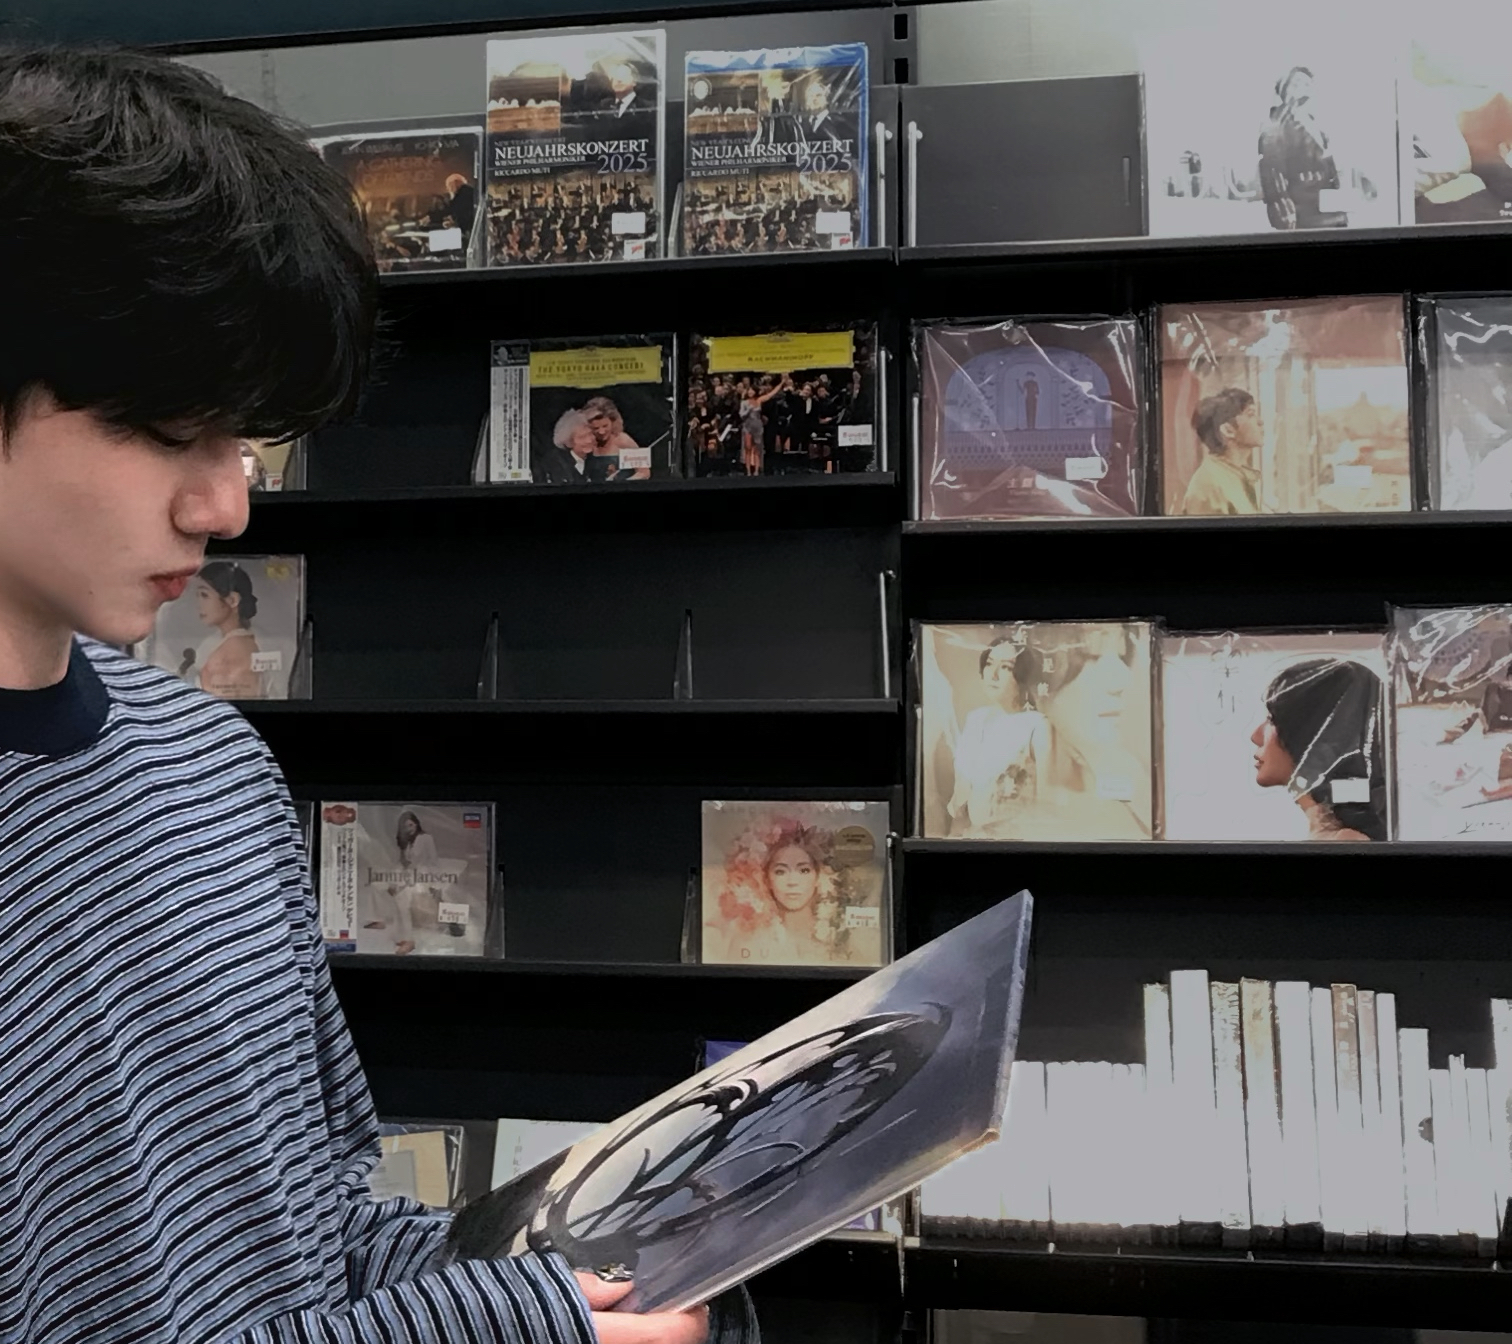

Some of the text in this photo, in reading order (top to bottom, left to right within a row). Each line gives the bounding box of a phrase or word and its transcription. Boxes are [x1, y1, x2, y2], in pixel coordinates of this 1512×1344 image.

[495, 138, 649, 160] NEUJAHRSKONZERT
[691, 138, 854, 160] NEUJAHRSKONZERT
[597, 153, 648, 175] 2025
[799, 153, 853, 175] 2025
